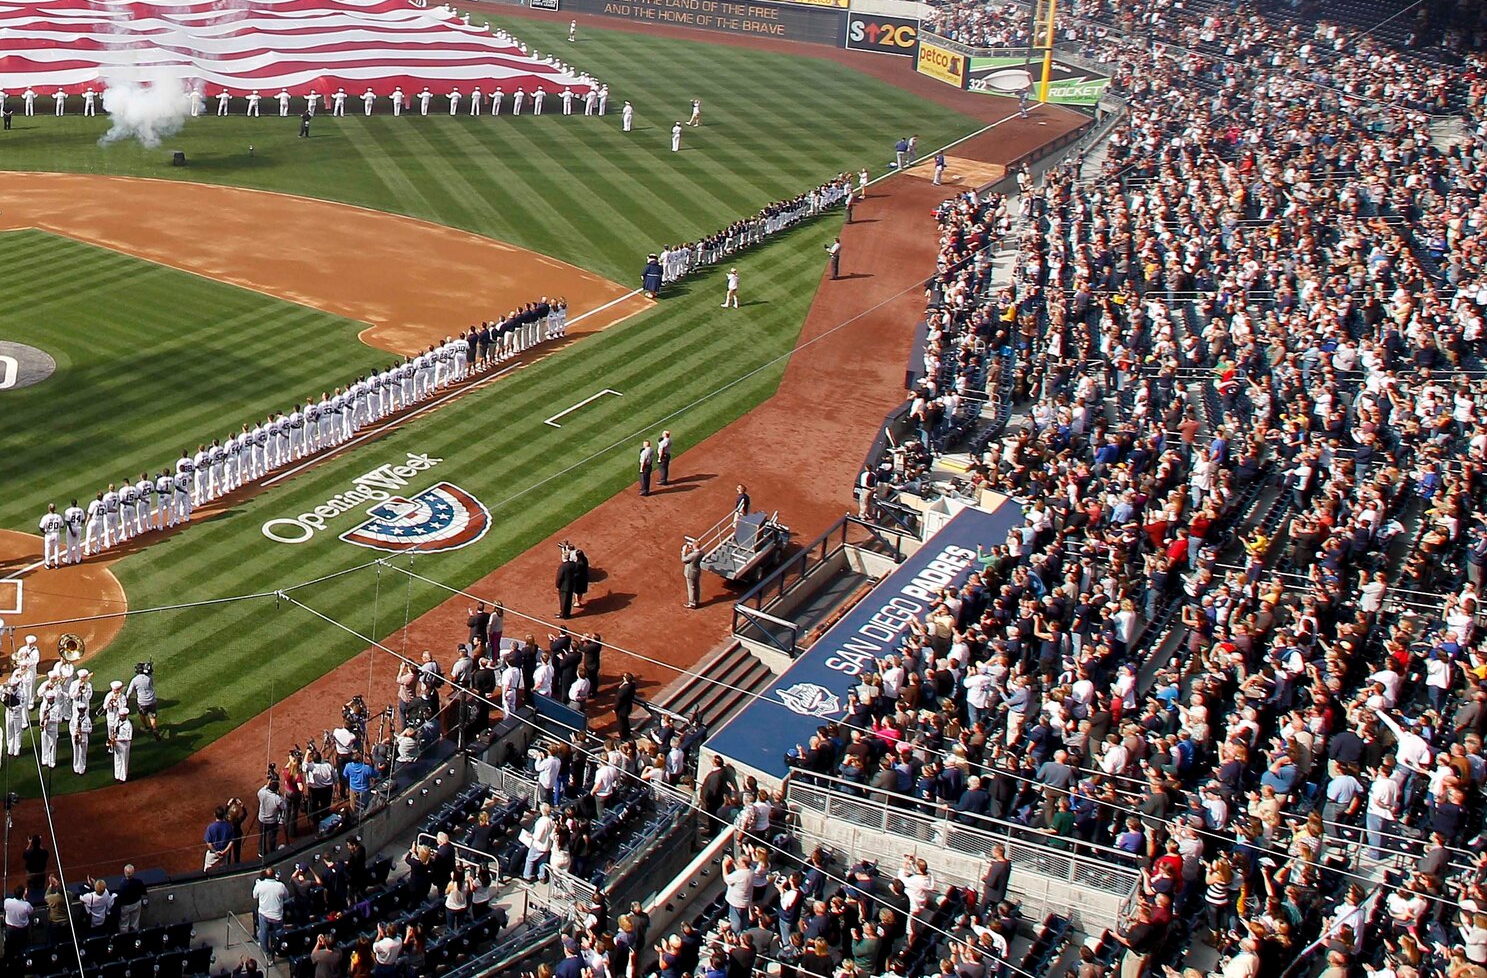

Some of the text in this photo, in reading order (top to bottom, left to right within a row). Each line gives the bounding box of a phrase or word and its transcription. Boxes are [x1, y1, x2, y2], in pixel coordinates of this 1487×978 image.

[604, 4, 785, 36] AND THE HOME OF THE BRAVE
[702, 1, 717, 12] OF
[721, 3, 745, 15] THE
[749, 6, 779, 19] FREE
[920, 46, 949, 68] petco
[968, 79, 986, 91] 322
[1048, 86, 1102, 96] ROCKET
[262, 452, 443, 544] Opening Week
[825, 545, 977, 675] SAN DIEGO PADRES
